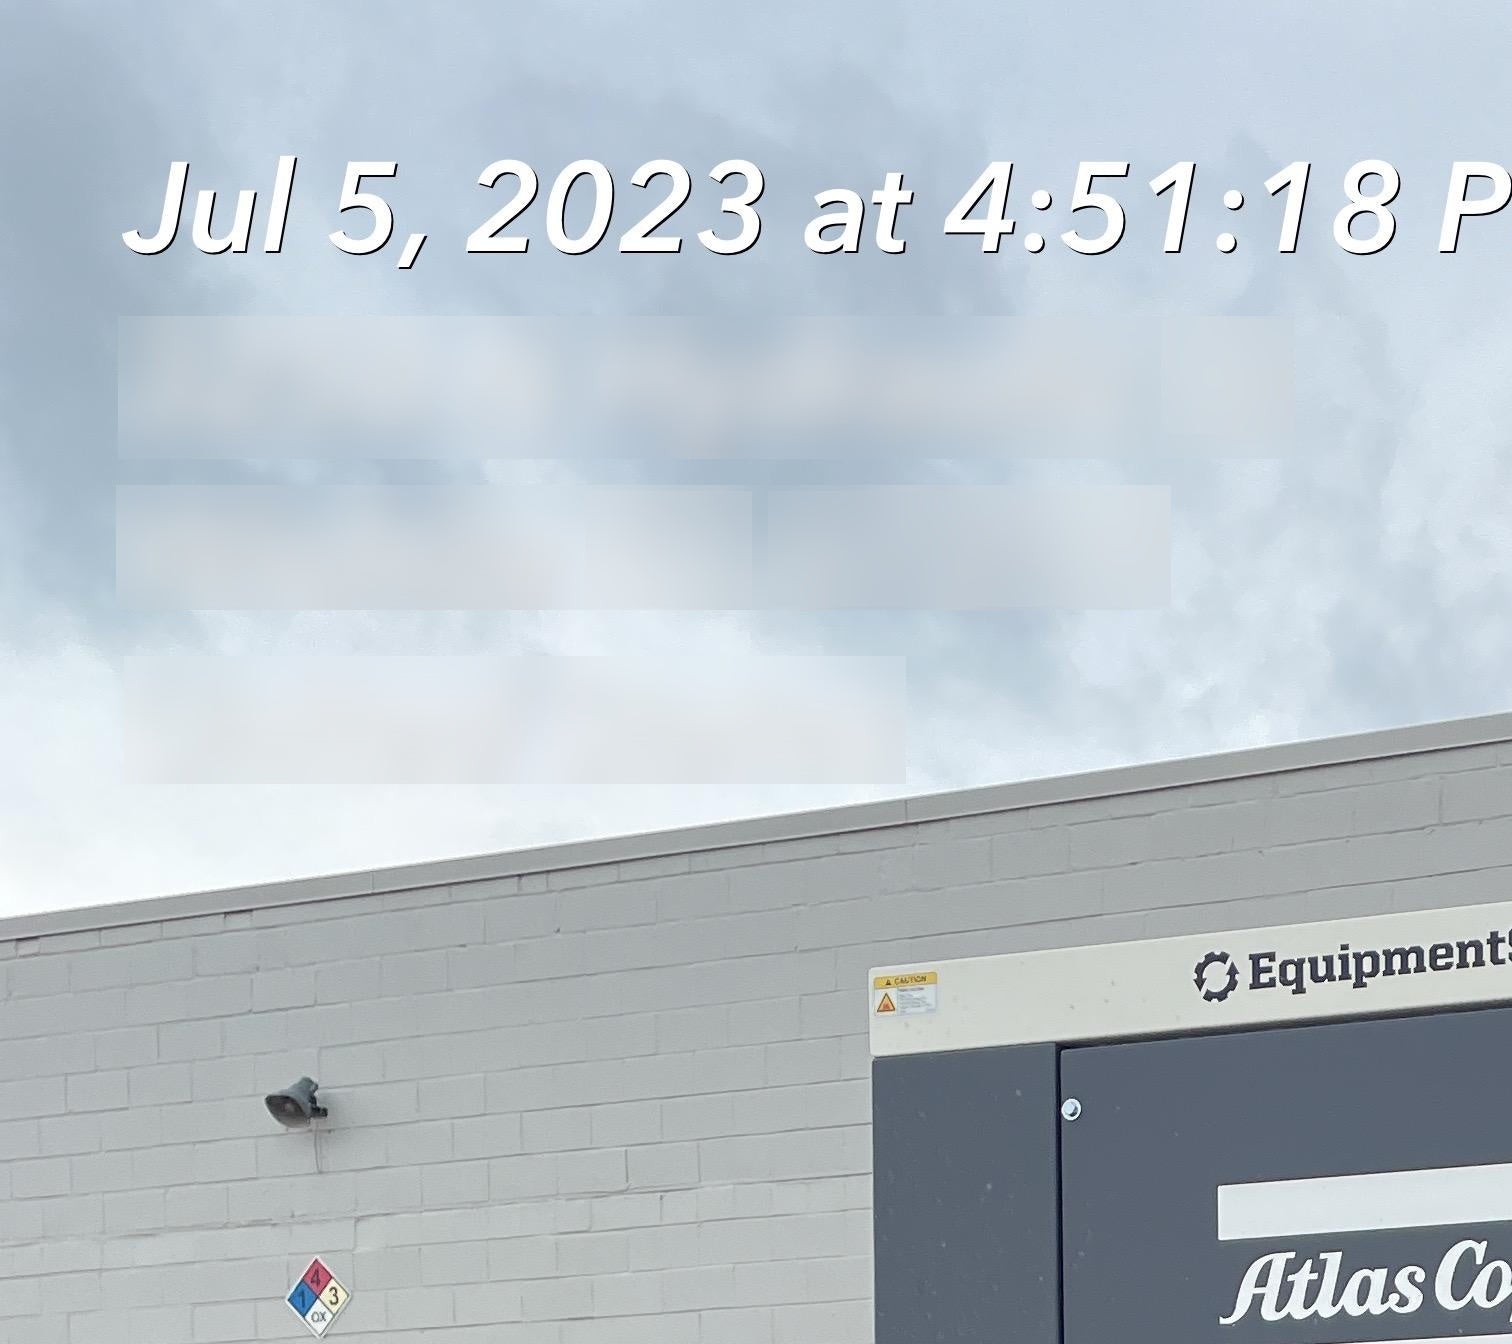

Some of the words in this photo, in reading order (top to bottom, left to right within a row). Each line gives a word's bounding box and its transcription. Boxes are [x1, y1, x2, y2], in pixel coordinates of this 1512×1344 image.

[310, 1267, 320, 1287] 4
[328, 1286, 339, 1305] 3
[1219, 1250, 1427, 1326] Atlas
[298, 1289, 305, 1308] 1
